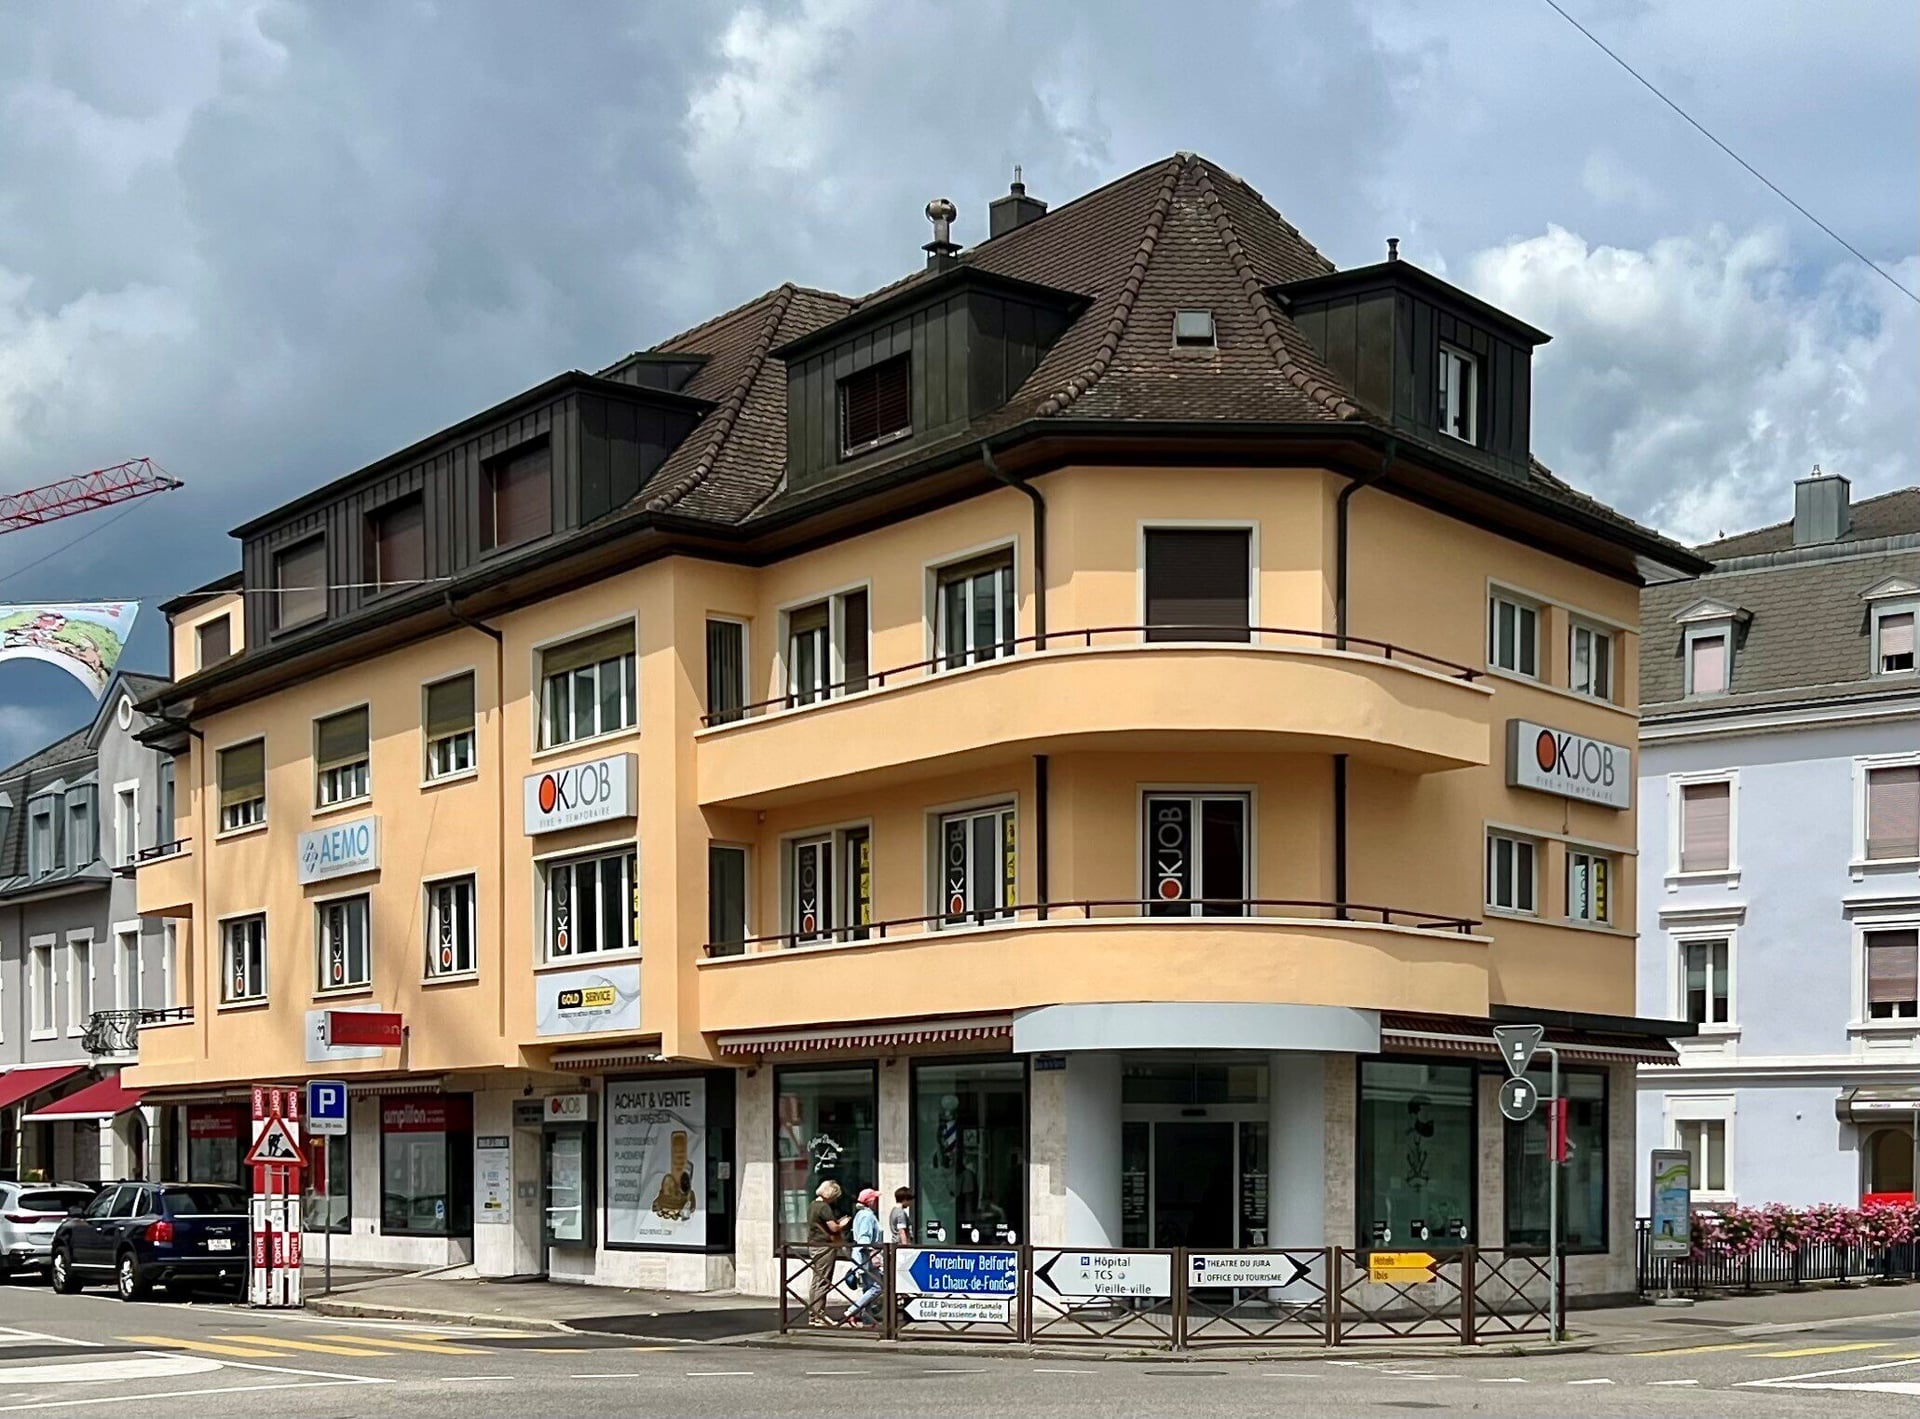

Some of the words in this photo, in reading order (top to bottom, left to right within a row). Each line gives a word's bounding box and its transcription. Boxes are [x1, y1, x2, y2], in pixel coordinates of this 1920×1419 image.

[1536, 730, 1614, 786] OKJOB
[539, 762, 611, 814] OKJOB
[320, 825, 369, 864] AEMO
[1158, 807, 1182, 900] OKJOB
[950, 825, 964, 914] OKJOB
[803, 851, 815, 934] OKJOB
[557, 872, 568, 951] OKJO
[442, 890, 451, 967] OKJO
[561, 993, 579, 1005] GOLD
[585, 990, 611, 1002] SERVICE
[271, 1089, 280, 1117] COMT
[319, 1089, 336, 1114] P
[614, 1092, 647, 1109] ACHAT
[650, 1092, 655, 1108] &
[658, 1091, 691, 1108] VENTE
[929, 1254, 975, 1272] Porrentruy
[979, 1255, 1009, 1270] Belfort
[1094, 1256, 1131, 1268] Hôpital
[929, 1274, 939, 1289] La
[942, 1275, 1008, 1290] Chaux-de-Fonds
[1094, 1270, 1113, 1280] TCS
[1094, 1284, 1152, 1294] Vieille-ville
[919, 1300, 939, 1308] CEJEF
[940, 1301, 968, 1309] Division
[939, 1311, 977, 1319] jurassienne
[988, 1311, 1003, 1319] bois
